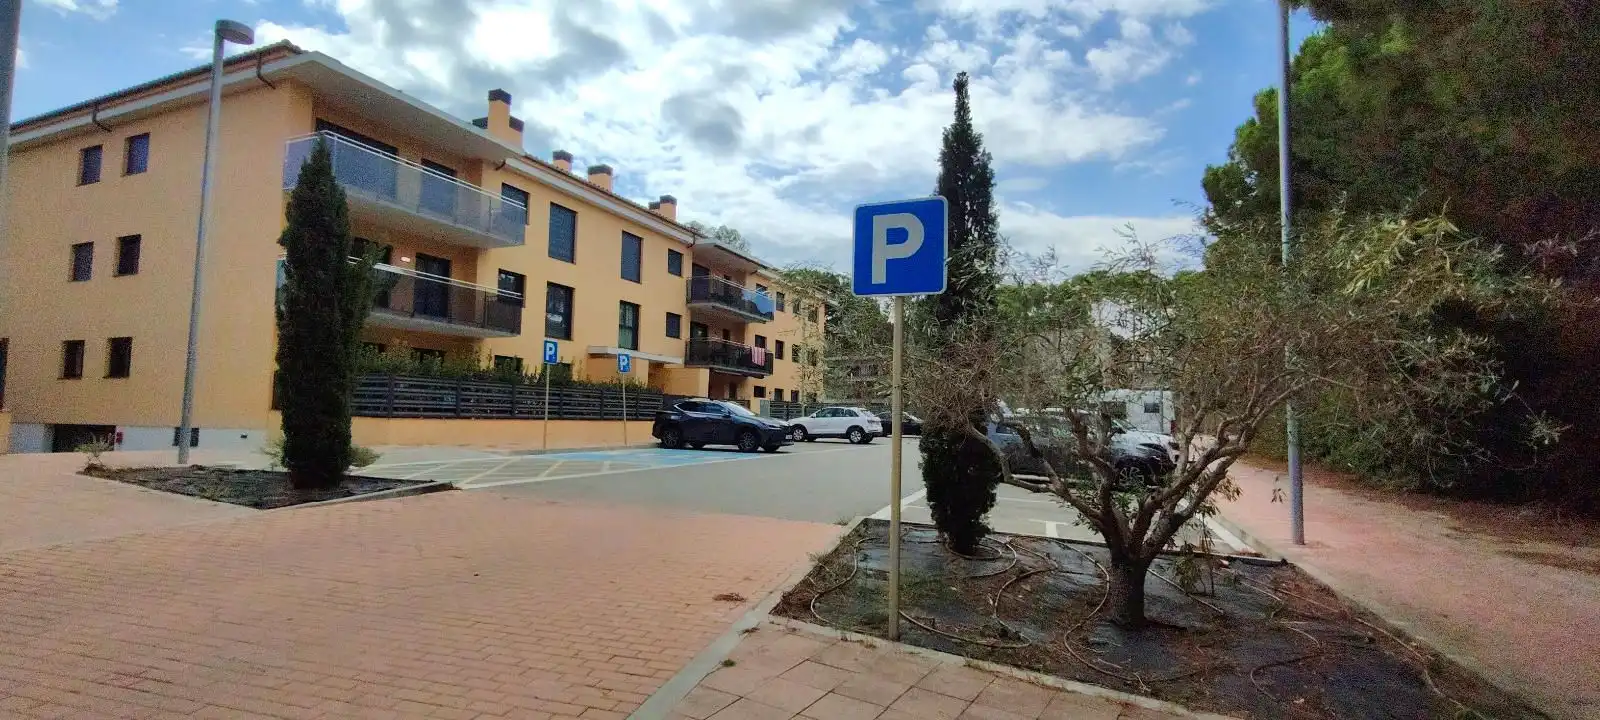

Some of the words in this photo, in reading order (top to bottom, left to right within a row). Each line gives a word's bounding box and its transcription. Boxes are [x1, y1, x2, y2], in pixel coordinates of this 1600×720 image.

[872, 212, 924, 284] P
[546, 343, 555, 360] P
[620, 355, 627, 370] P
